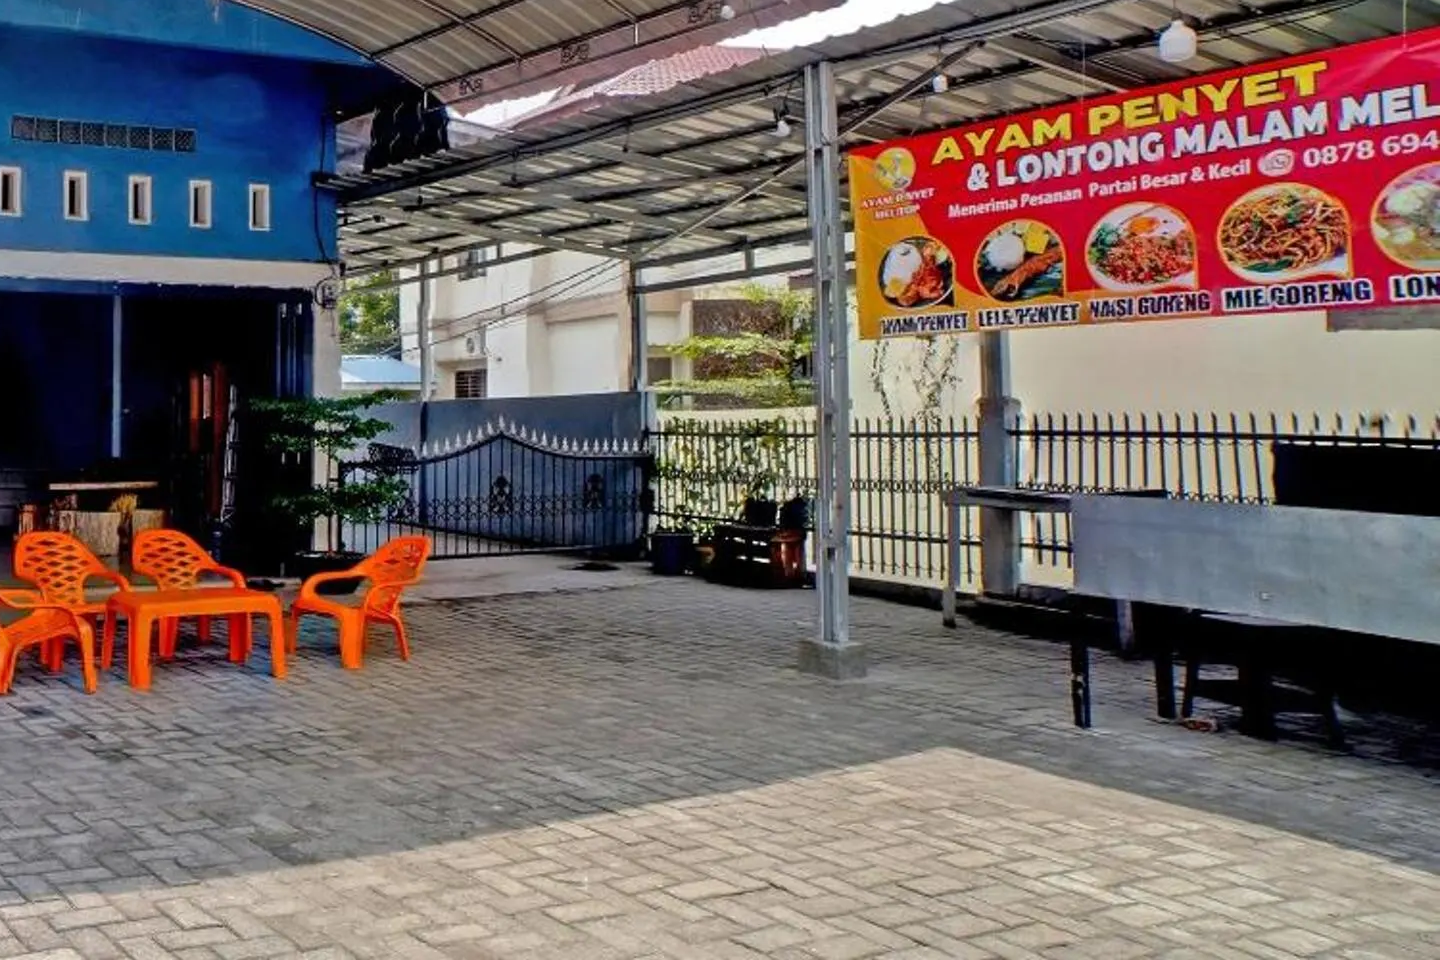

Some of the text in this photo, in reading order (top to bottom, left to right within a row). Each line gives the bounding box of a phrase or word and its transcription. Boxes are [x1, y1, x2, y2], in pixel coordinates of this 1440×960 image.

[931, 61, 1327, 165] AYAM PENYET
[967, 83, 1440, 191] & LONTONG MALAM MEL
[1303, 129, 1440, 168] 0878 694
[947, 158, 1251, 219] Menerima Pesanan Partai Besar & Kecil
[1224, 279, 1372, 310] MIE GORENG
[1391, 274, 1440, 300] LON
[917, 311, 969, 332] PENYET
[977, 302, 1080, 328] LELE PENYET
[1090, 297, 1135, 319] NASI
